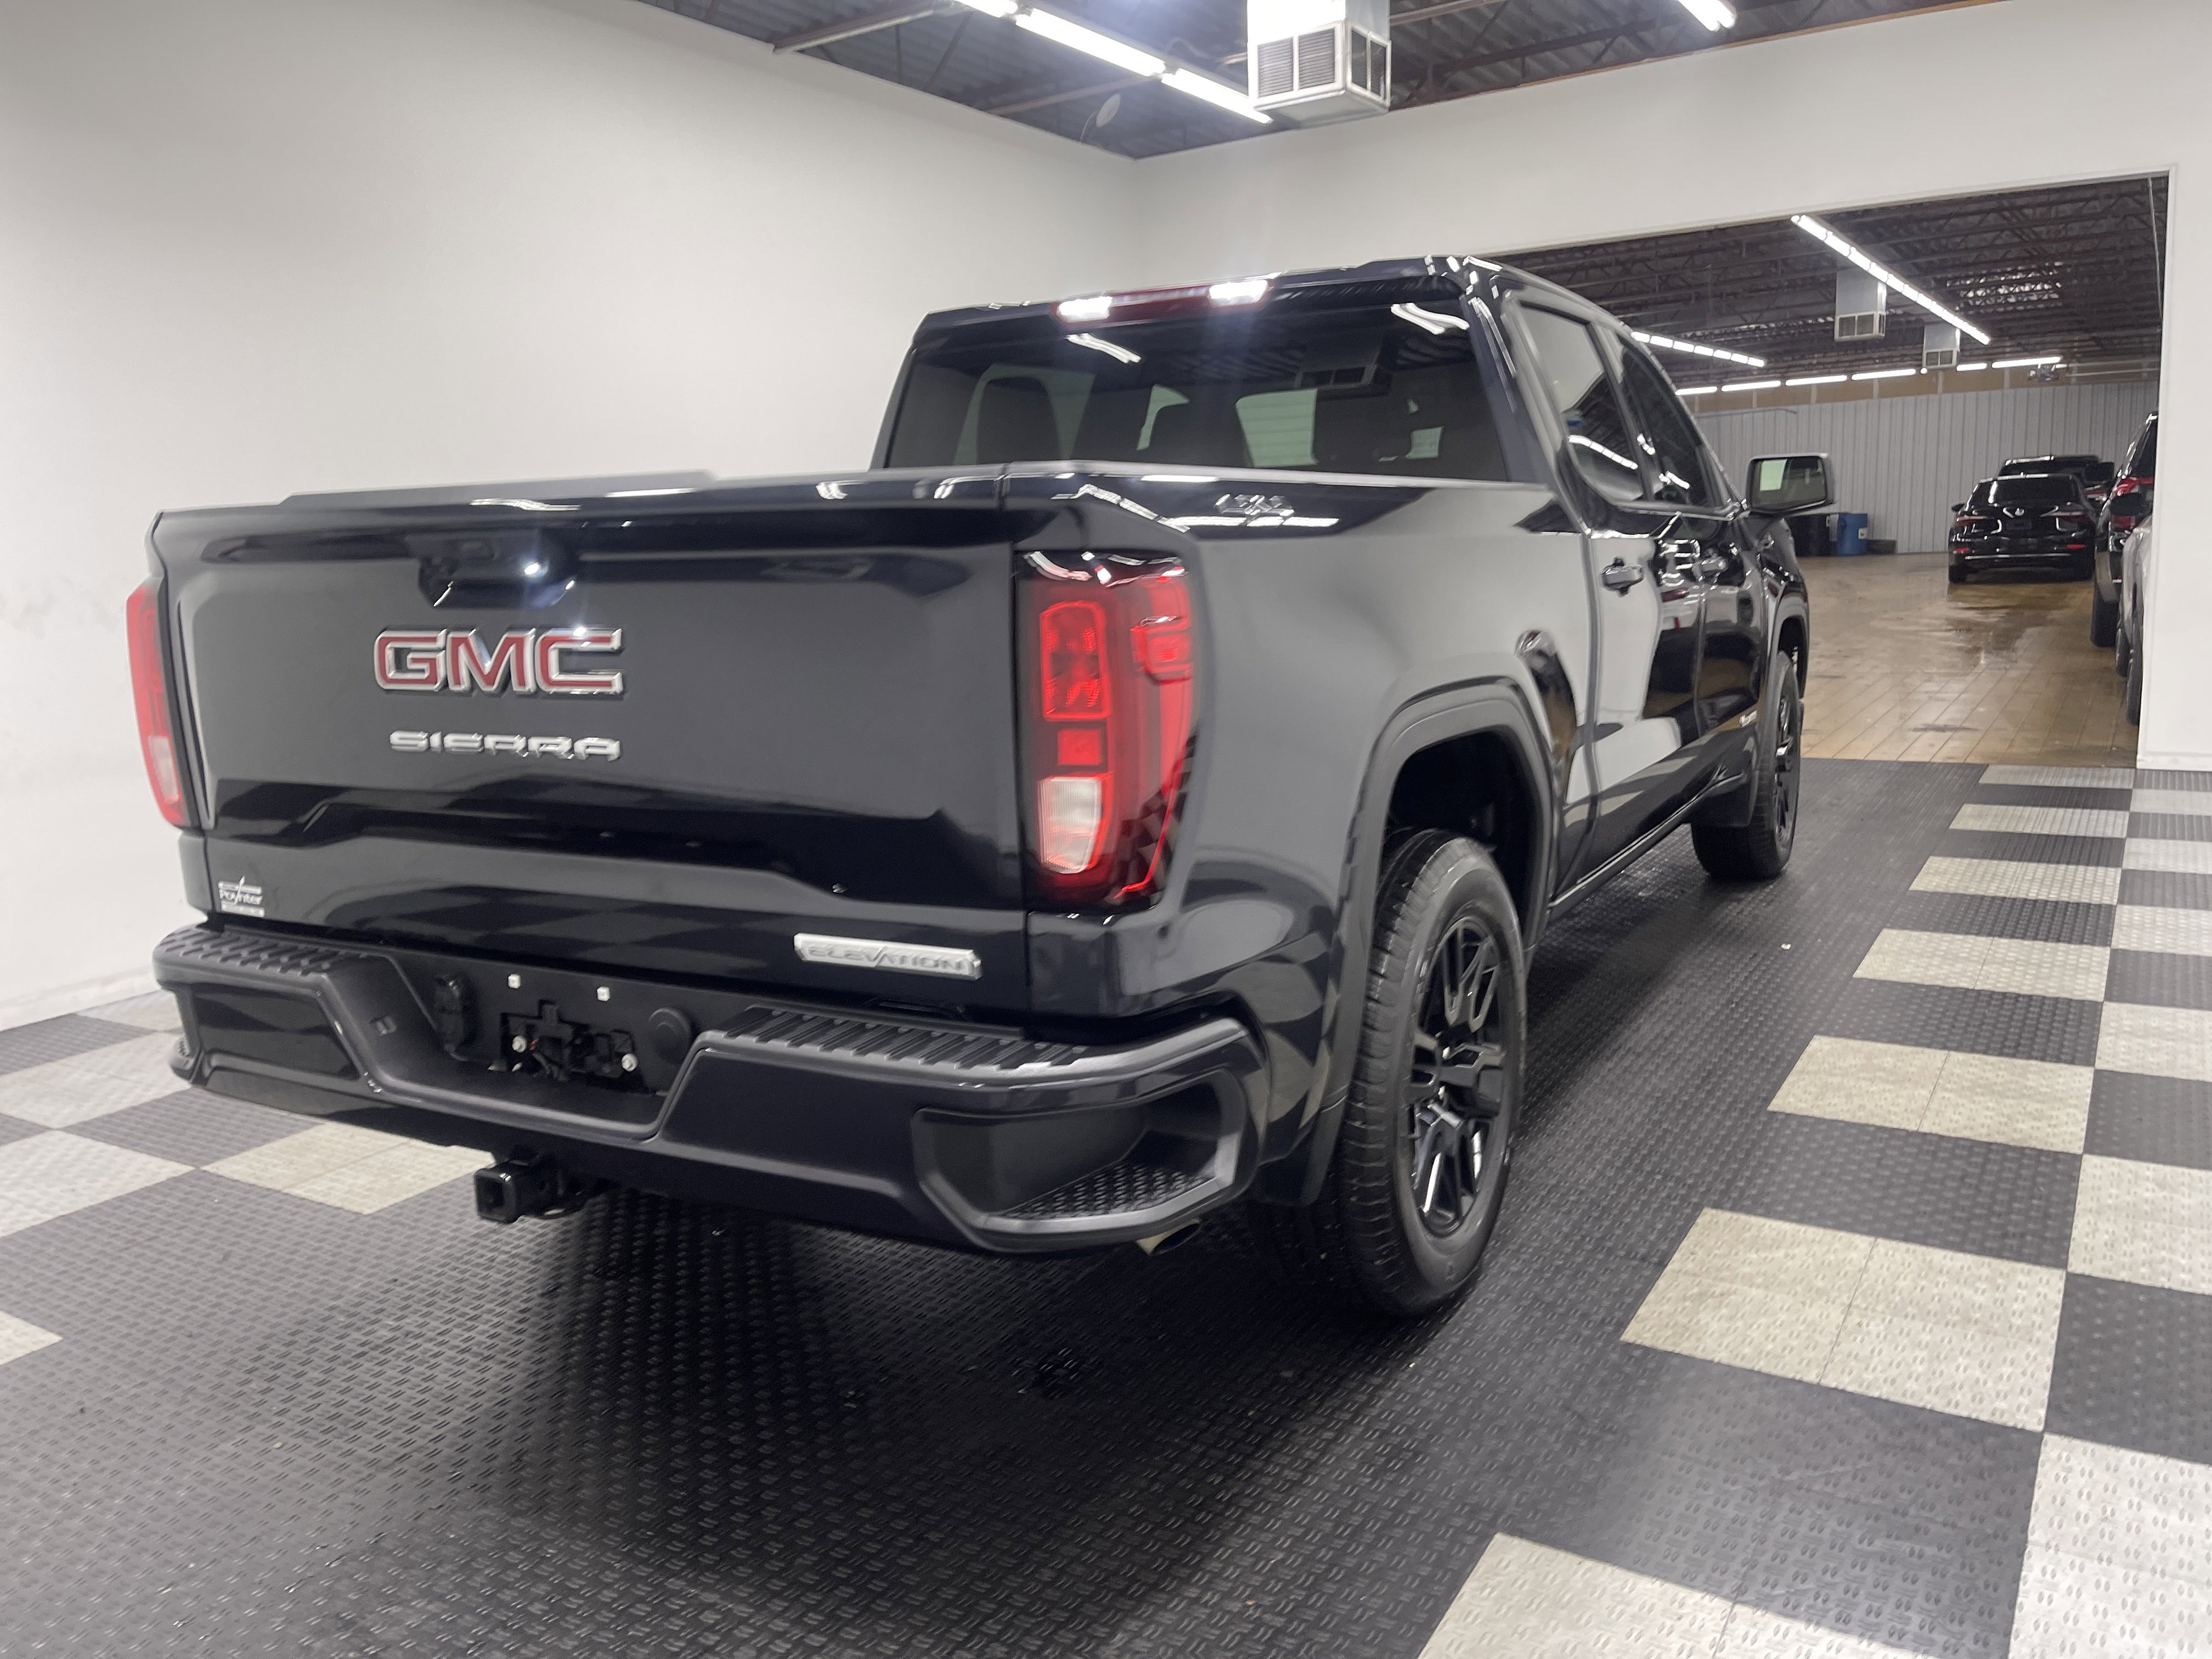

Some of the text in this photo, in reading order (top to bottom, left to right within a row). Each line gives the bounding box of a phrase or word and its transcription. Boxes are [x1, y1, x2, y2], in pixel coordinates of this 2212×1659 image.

[374, 628, 624, 695] GMC
[389, 730, 621, 761] SIERRA
[805, 941, 970, 974] ELEVATION
